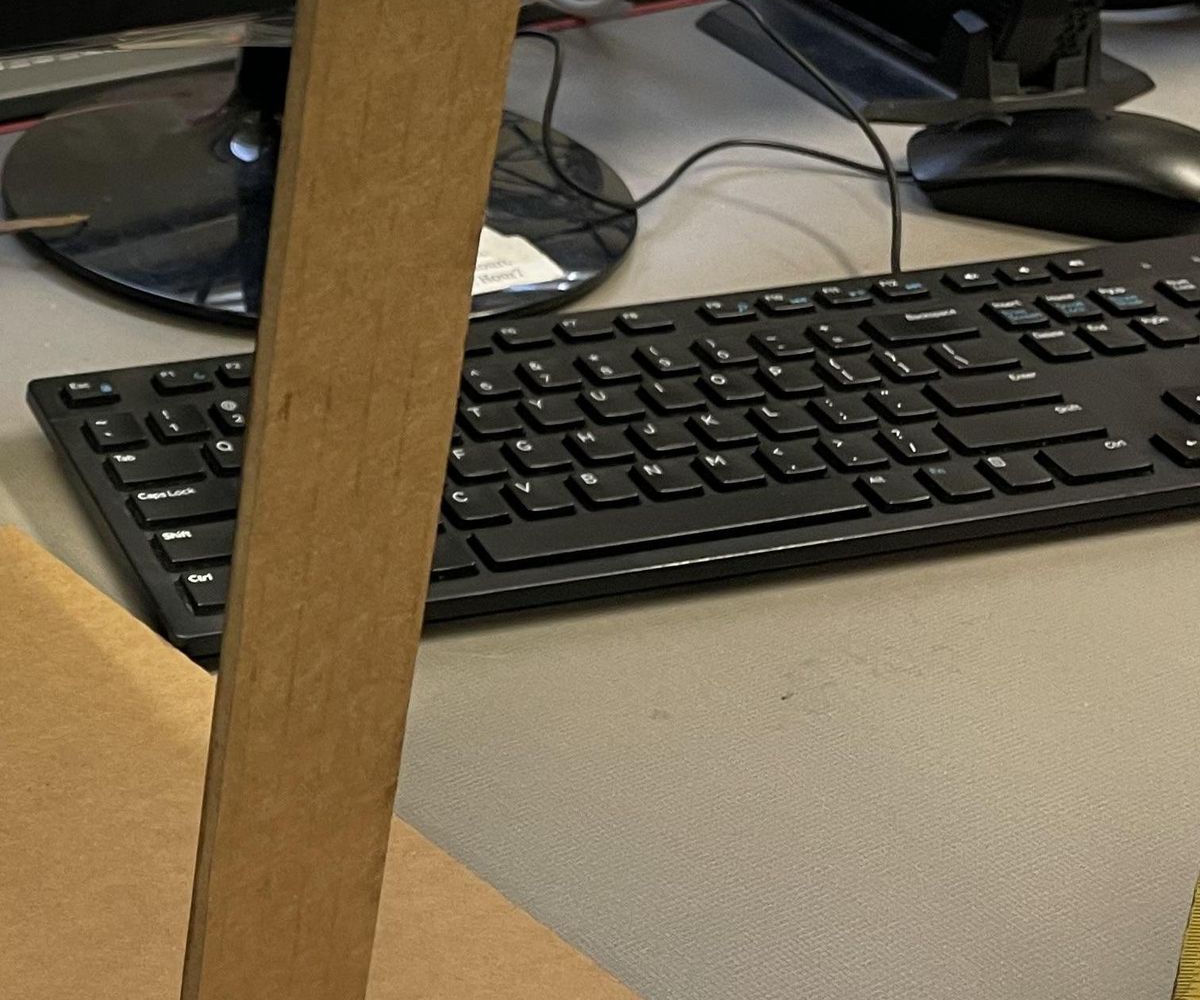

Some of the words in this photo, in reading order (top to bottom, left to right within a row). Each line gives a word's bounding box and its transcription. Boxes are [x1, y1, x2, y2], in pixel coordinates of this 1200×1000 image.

[113, 454, 137, 462] Tab
[137, 492, 167, 501] Caps
[166, 486, 197, 498] Lock
[161, 530, 193, 541] Shift
[187, 572, 214, 583] Ctrl
